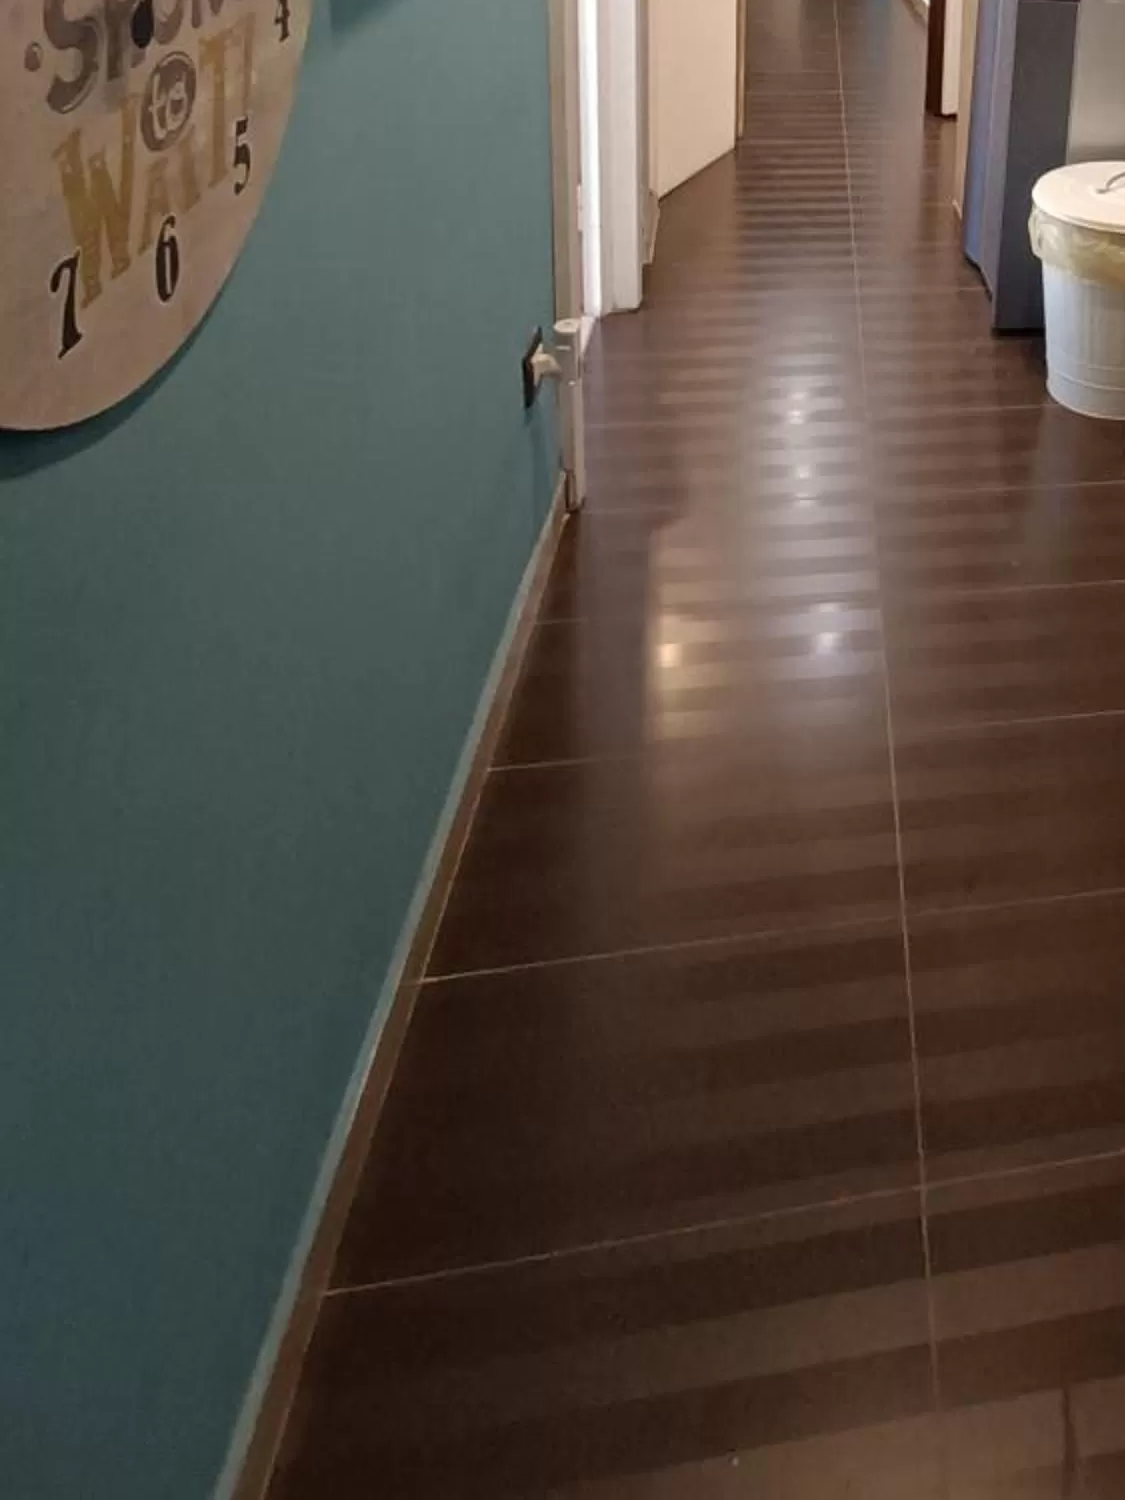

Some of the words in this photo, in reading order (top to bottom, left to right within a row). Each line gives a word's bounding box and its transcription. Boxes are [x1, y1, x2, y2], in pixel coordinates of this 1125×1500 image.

[233, 115, 252, 196] 5
[154, 215, 181, 303] 6
[49, 247, 84, 360] 7
